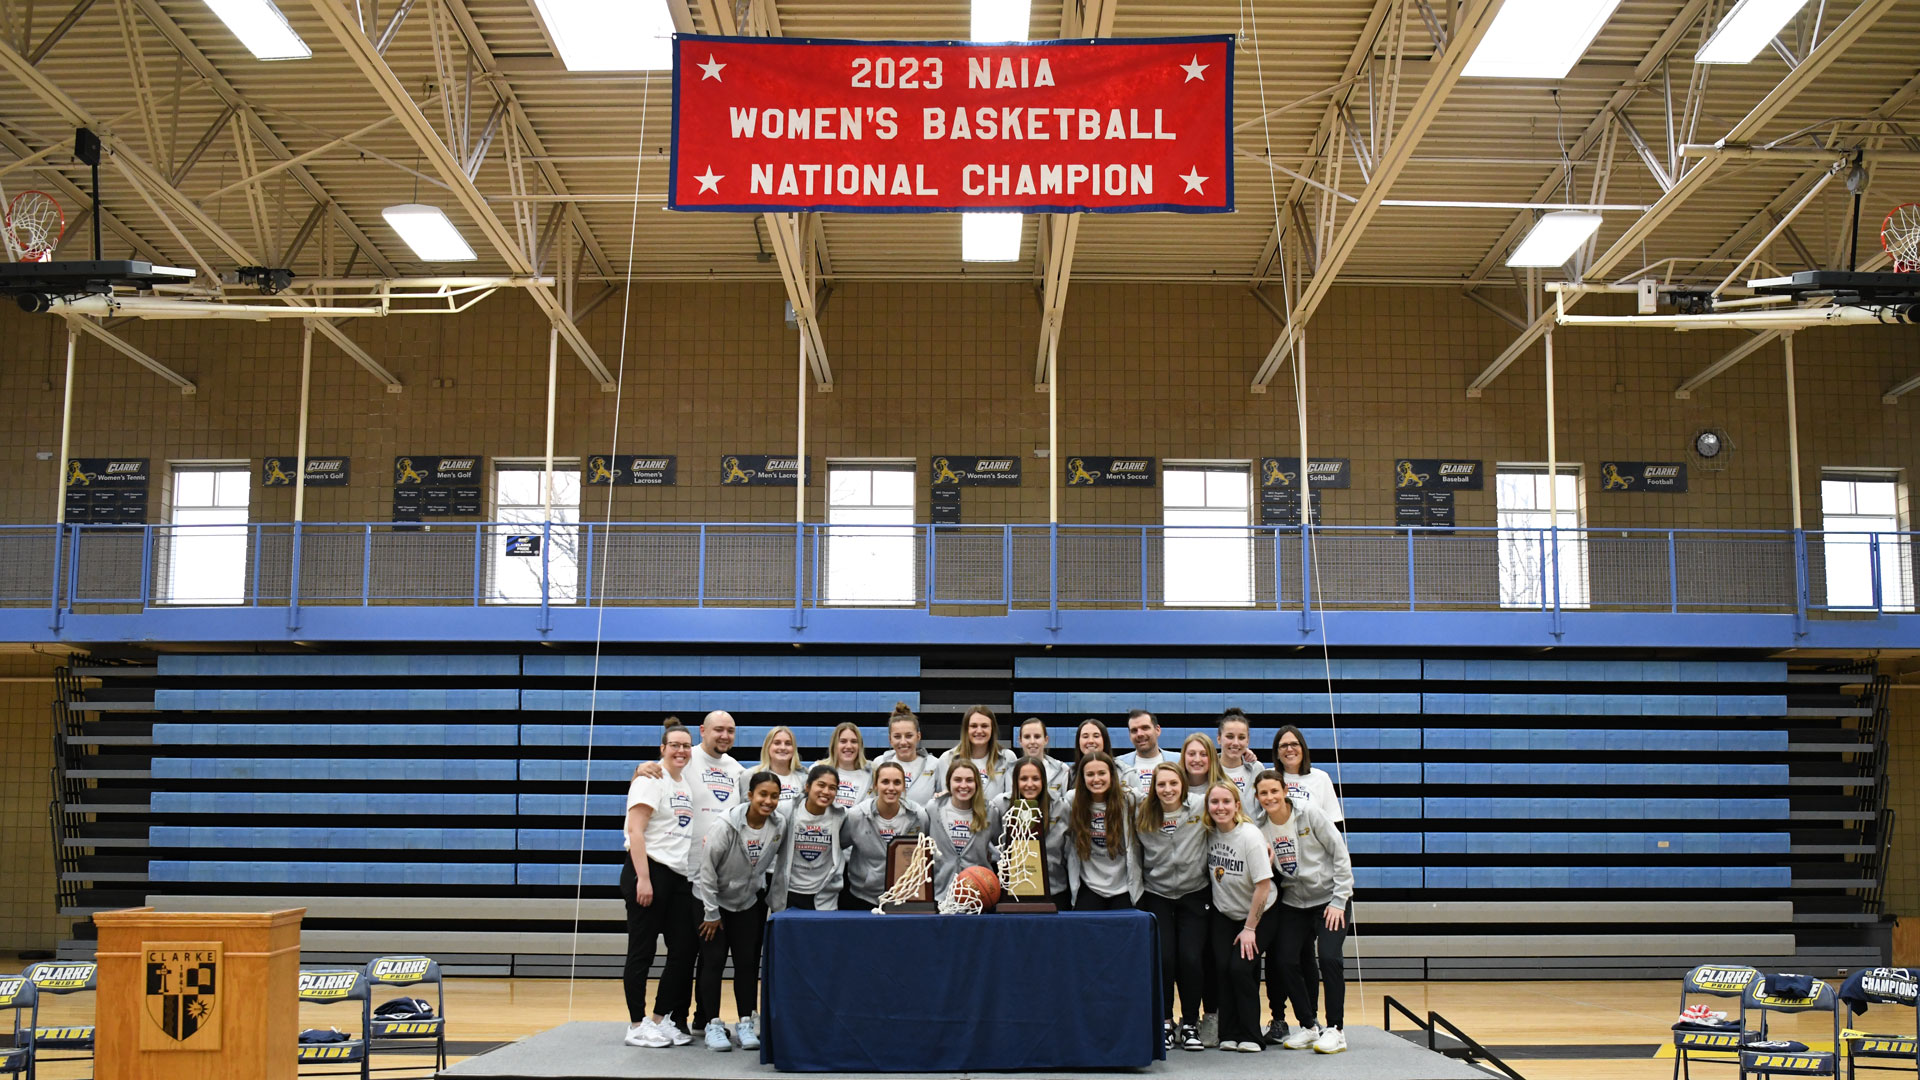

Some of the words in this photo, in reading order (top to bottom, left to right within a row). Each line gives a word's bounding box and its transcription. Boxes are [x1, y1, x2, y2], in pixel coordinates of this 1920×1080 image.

[852, 57, 943, 90] 2023
[968, 57, 1055, 89] NAIA
[729, 106, 899, 140] WOMEN'S
[923, 106, 1177, 141] BASKETBALL
[750, 163, 939, 196] NATIONAL
[962, 163, 1154, 196] CHAMPION
[107, 463, 140, 473] CLARKE
[307, 462, 340, 472] CLARKE
[440, 460, 473, 470] CLARKE
[633, 460, 667, 470] CLARKE
[977, 461, 1011, 471] CLARKE
[1112, 462, 1146, 471] CLARKE
[1307, 463, 1340, 473] CLARKE
[1440, 464, 1473, 474] CLARKE
[1645, 467, 1677, 477] CLARKE
[1210, 843, 1237, 857] NATIONAL
[149, 952, 213, 962] CLARKE
[375, 960, 428, 975] CLARKE
[33, 966, 93, 981] CLARKE
[1695, 969, 1752, 984] CLARKE
[299, 974, 356, 990] CLARKE
[1861, 976, 1919, 998] CHAMPIONS
[35, 1028, 92, 1039] PRIDE
[384, 1023, 438, 1034] PRIDE
[1681, 1033, 1740, 1046] PRIDE
[1754, 1055, 1822, 1069] PRIDE
